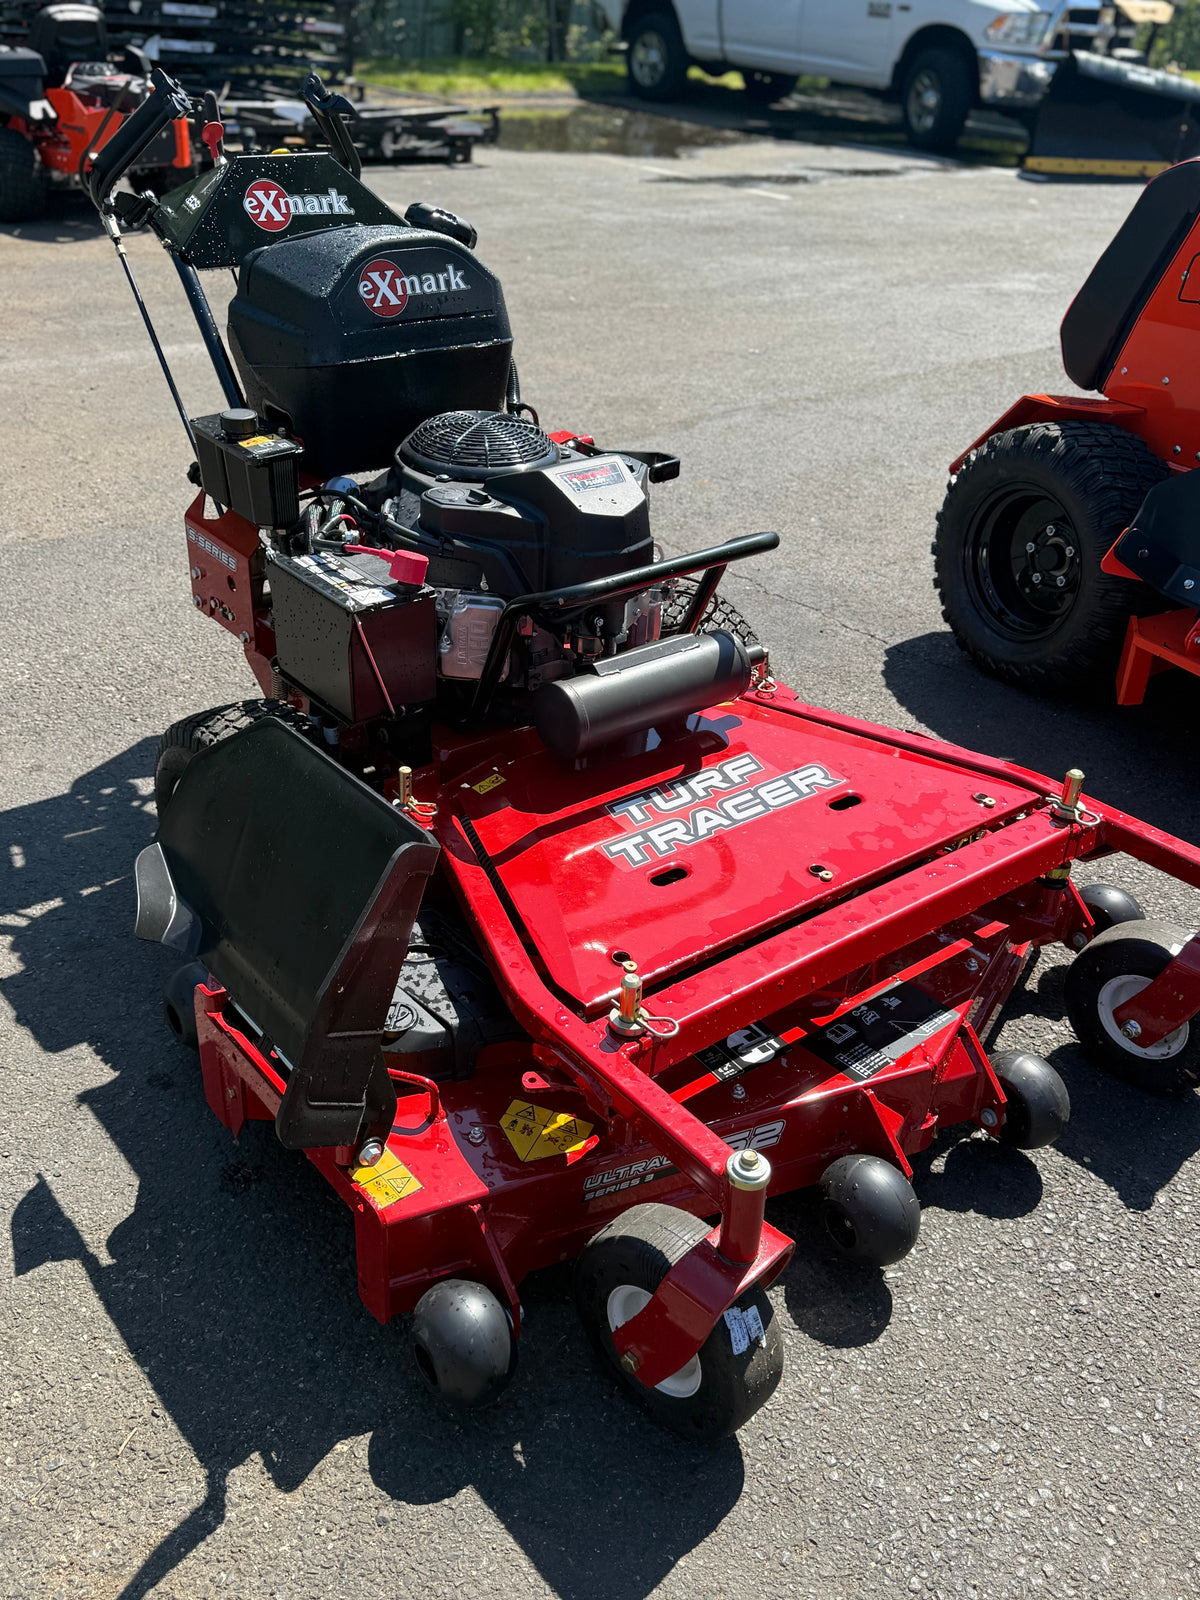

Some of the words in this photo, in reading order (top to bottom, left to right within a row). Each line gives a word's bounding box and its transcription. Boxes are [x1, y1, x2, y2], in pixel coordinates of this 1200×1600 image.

[187, 527, 236, 572] S-SERIES
[601, 764, 846, 867] TRACER
[606, 752, 765, 825] TURF
[583, 1179, 640, 1201] SERIES
